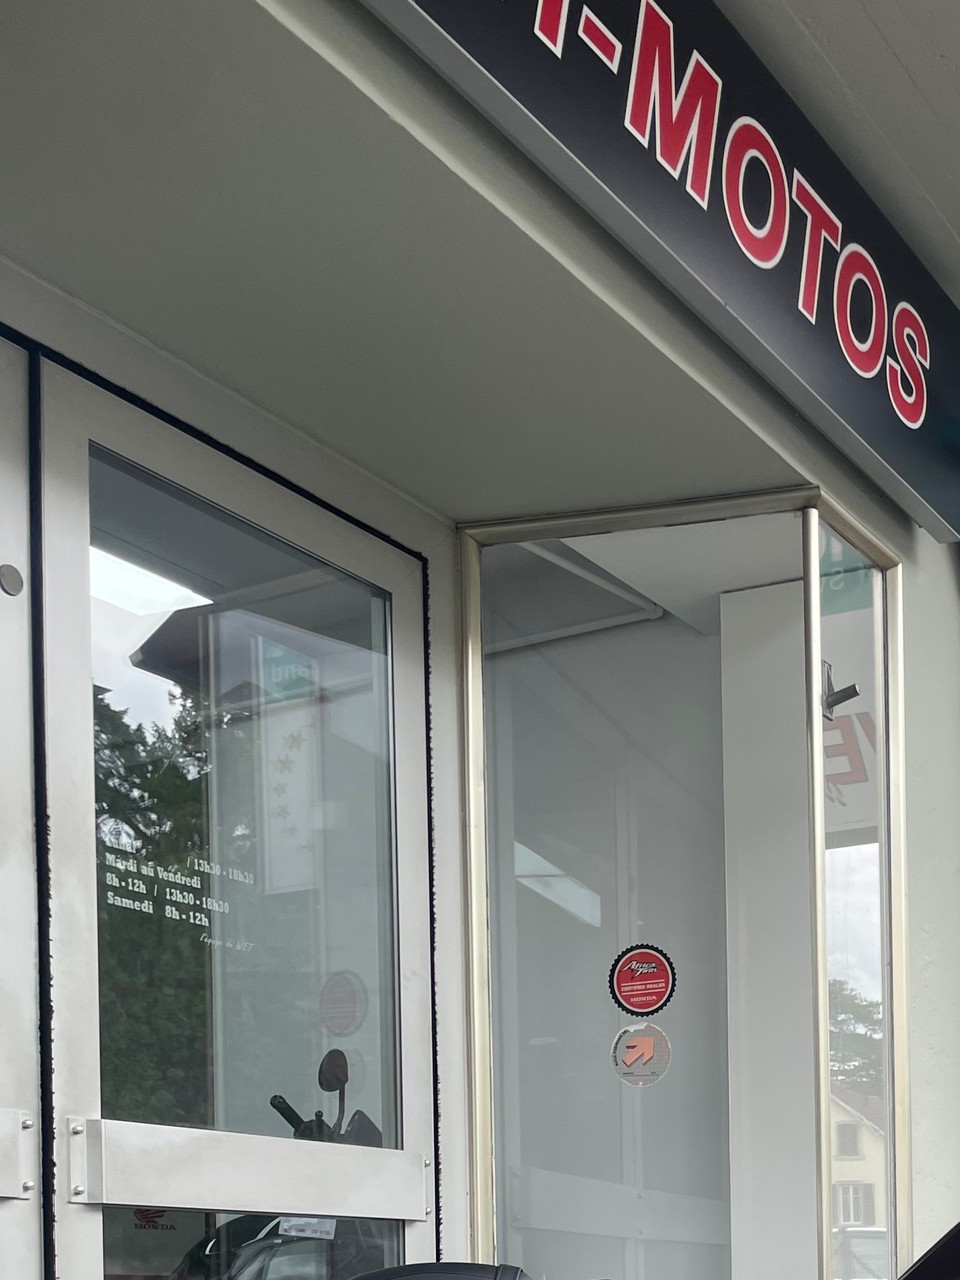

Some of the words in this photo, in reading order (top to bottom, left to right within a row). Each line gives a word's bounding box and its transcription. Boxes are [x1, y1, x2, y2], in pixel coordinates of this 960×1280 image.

[105, 852, 137, 873] Mardi
[140, 865, 154, 877] au
[157, 867, 201, 889] Vendredi
[193, 858, 221, 876] 13h30
[107, 892, 153, 914] Samedi
[166, 888, 195, 906] 13h30
[202, 897, 229, 914] 18h30
[621, 961, 657, 972] Africa
[634, 967, 659, 978] Twin
[621, 984, 646, 992] CERTIFIED
[630, 995, 658, 1003] HONDA
[134, 1223, 176, 1231] HONDA
